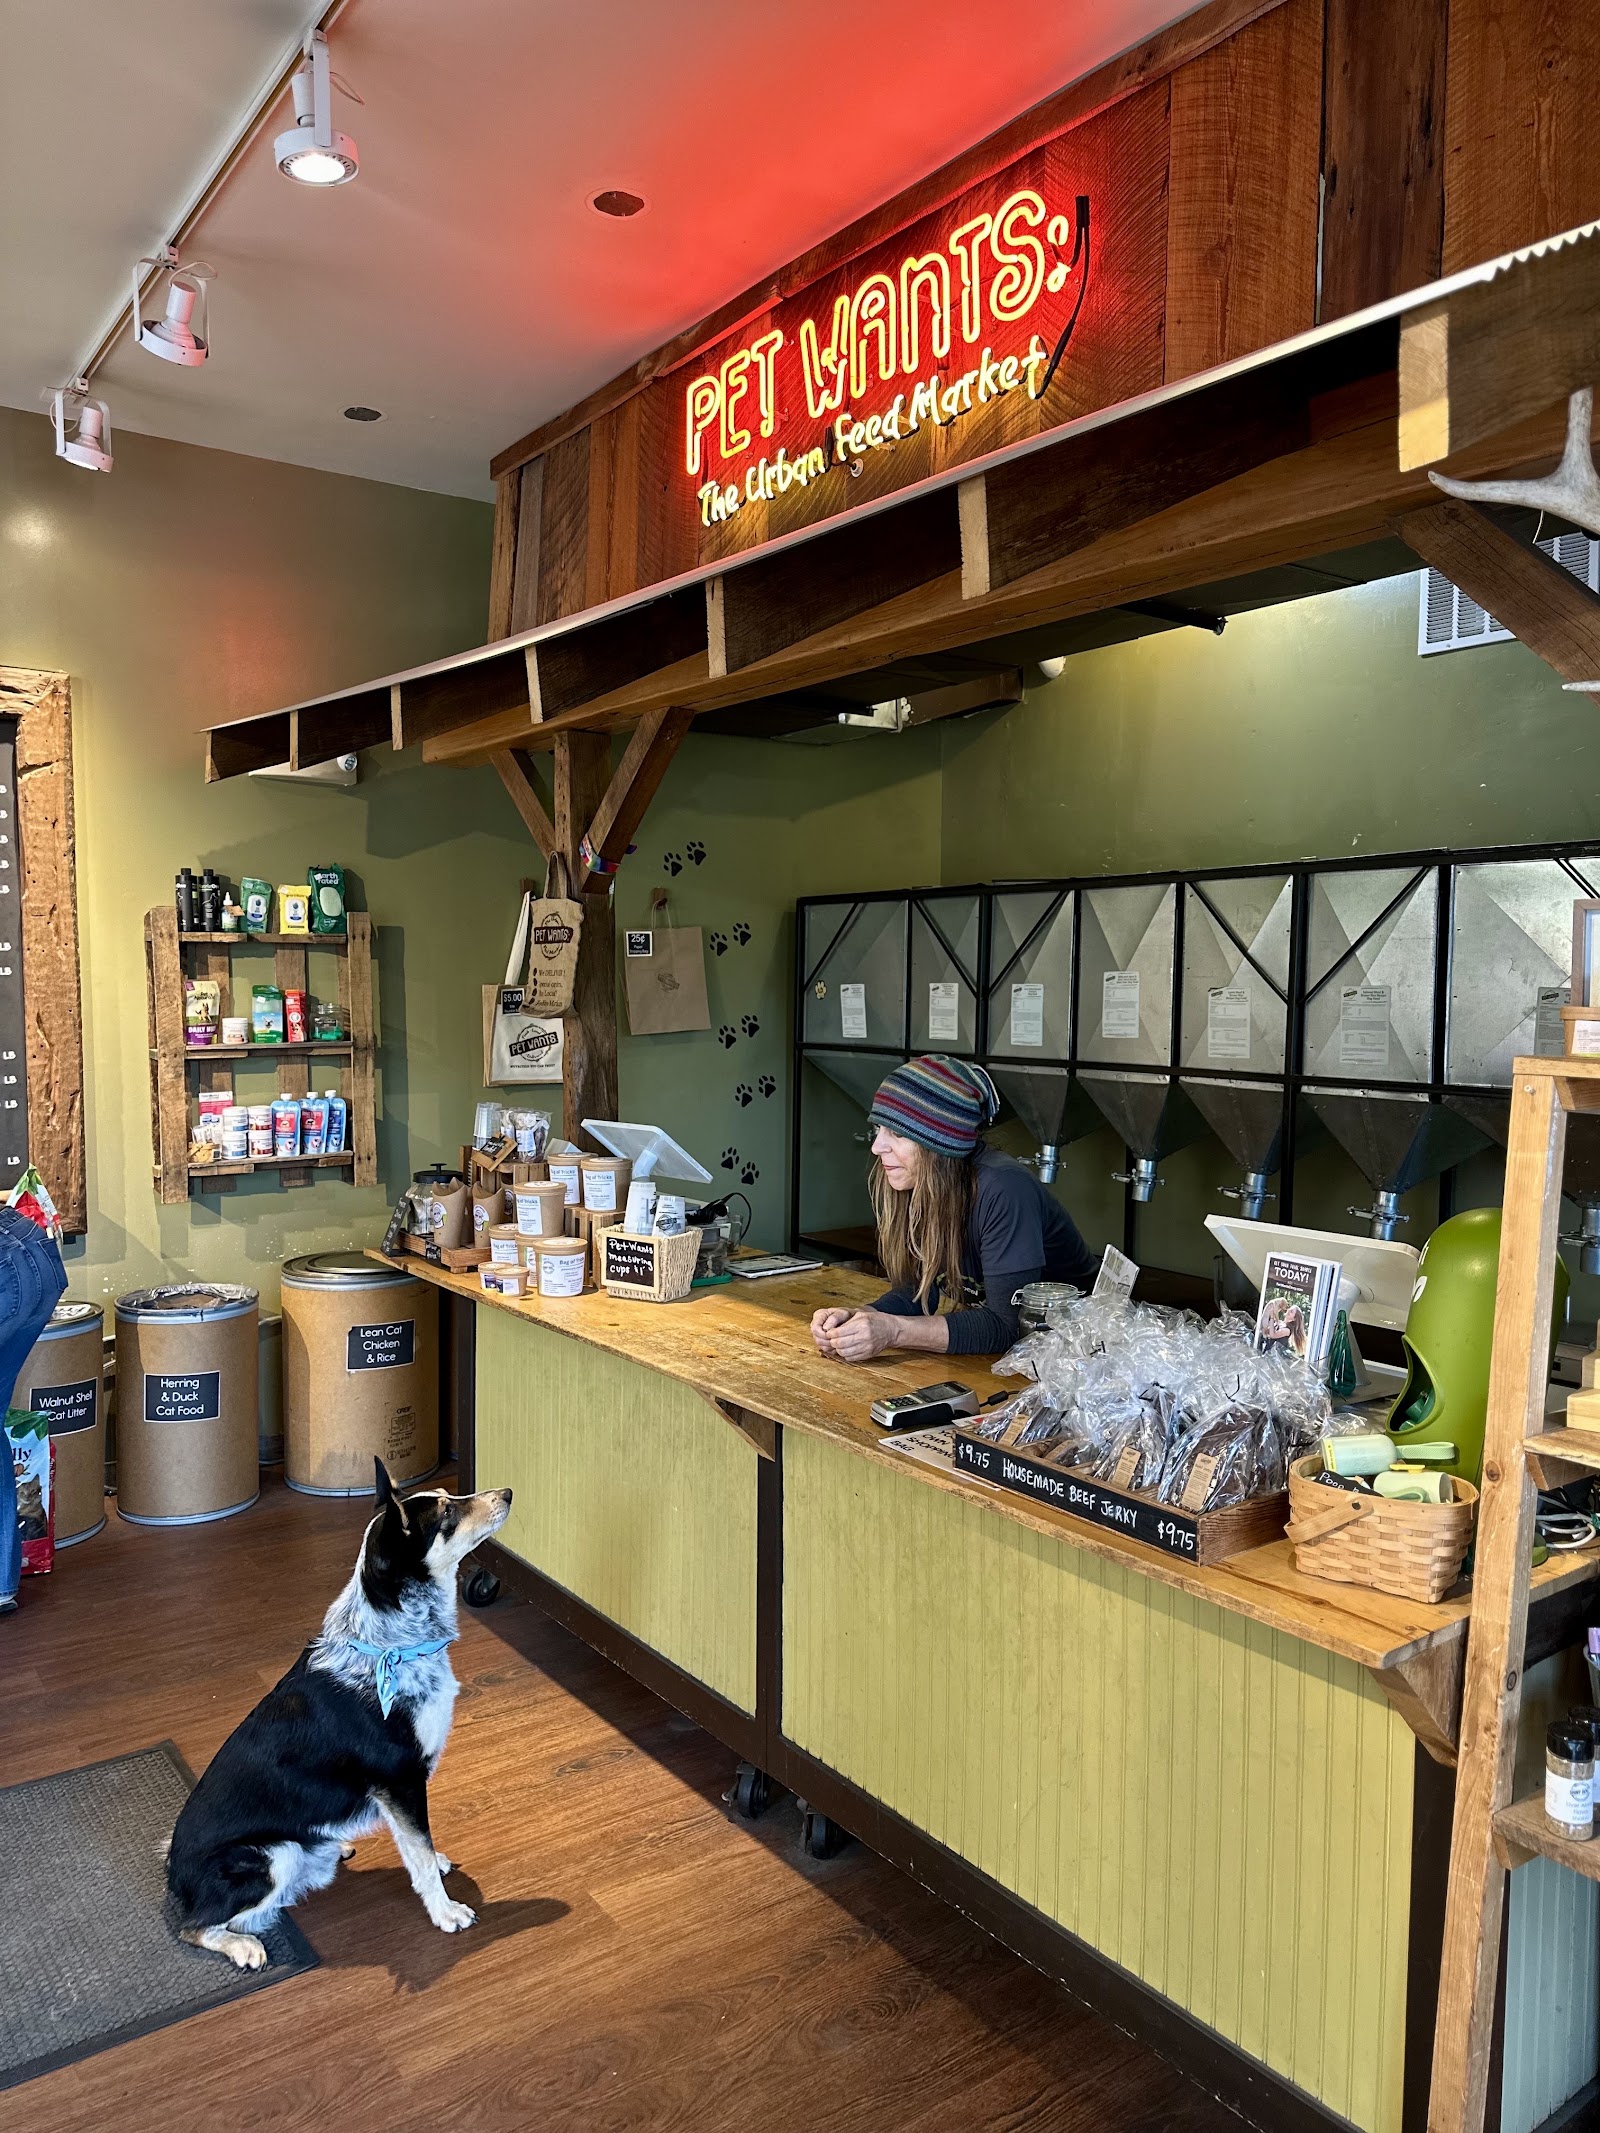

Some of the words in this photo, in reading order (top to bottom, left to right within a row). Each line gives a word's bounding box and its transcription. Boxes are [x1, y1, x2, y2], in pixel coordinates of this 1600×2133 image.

[686, 329, 784, 475] PET
[698, 480, 739, 527] The
[745, 448, 826, 502] Urban
[834, 393, 906, 462] Feed
[909, 335, 1047, 426] Market
[314, 872, 339, 880] arth
[631, 934, 646, 944] 25¢
[503, 994, 522, 1002] $5.00
[511, 1041, 526, 1055] PET
[3, 1051, 16, 1060] LB
[4, 1075, 17, 1084] LB
[5, 1100, 18, 1109] LB
[8, 1156, 20, 1165] LB
[608, 1252, 653, 1271] measuring
[610, 1265, 630, 1277] cups
[1274, 1267, 1310, 1283] TODAY!
[360, 1328, 383, 1338] Lean
[386, 1326, 402, 1335] Cat
[363, 1340, 400, 1351] Chicken
[366, 1354, 375, 1363] &
[377, 1353, 396, 1362] Rice
[160, 1378, 200, 1389] Herring
[39, 1395, 74, 1408] Walnut
[161, 1392, 170, 1402] &
[172, 1391, 199, 1402] Duck
[47, 1411, 66, 1421] Cat
[67, 1408, 87, 1419] Litter
[156, 1406, 175, 1416] Cat
[177, 1404, 204, 1415] Food
[922, 1433, 951, 1445] OWN
[890, 1440, 915, 1452] BAG
[1319, 1471, 1345, 1490] Poop
[958, 1443, 991, 1468] $9.75
[1003, 1458, 1065, 1497] HOUSEMADE
[1069, 1485, 1096, 1510] BEEF
[1100, 1501, 1138, 1528] JERKY
[1158, 1520, 1196, 1551] $9.75
